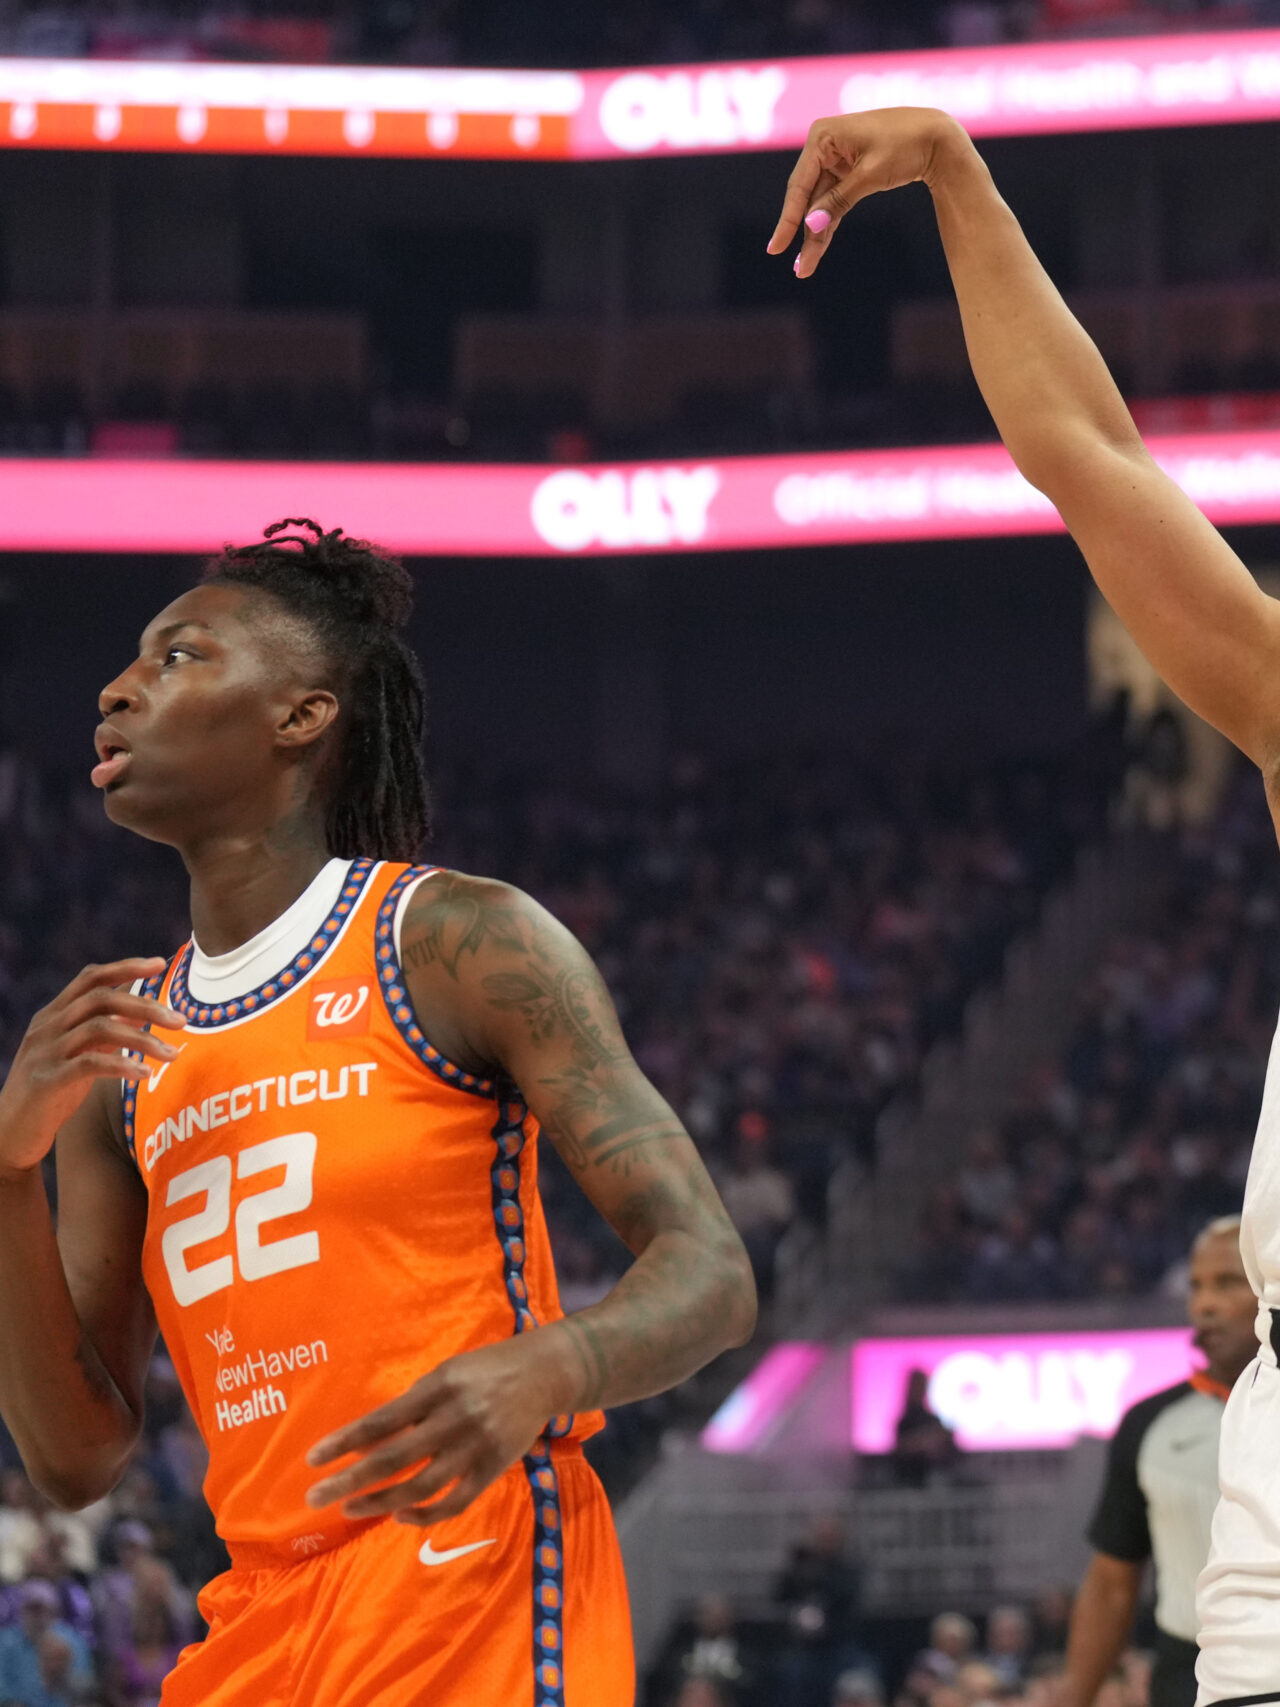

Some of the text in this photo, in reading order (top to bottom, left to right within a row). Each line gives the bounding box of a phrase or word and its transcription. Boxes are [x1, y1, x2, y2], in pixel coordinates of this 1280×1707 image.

[601, 67, 785, 150] OLLY
[1145, 54, 1235, 106] and
[531, 468, 719, 550] OLLY
[145, 1062, 377, 1170] CONNECTICUT
[162, 1131, 320, 1308] 22
[215, 1384, 287, 1432] Health
[927, 1350, 1136, 1434] OLLY
